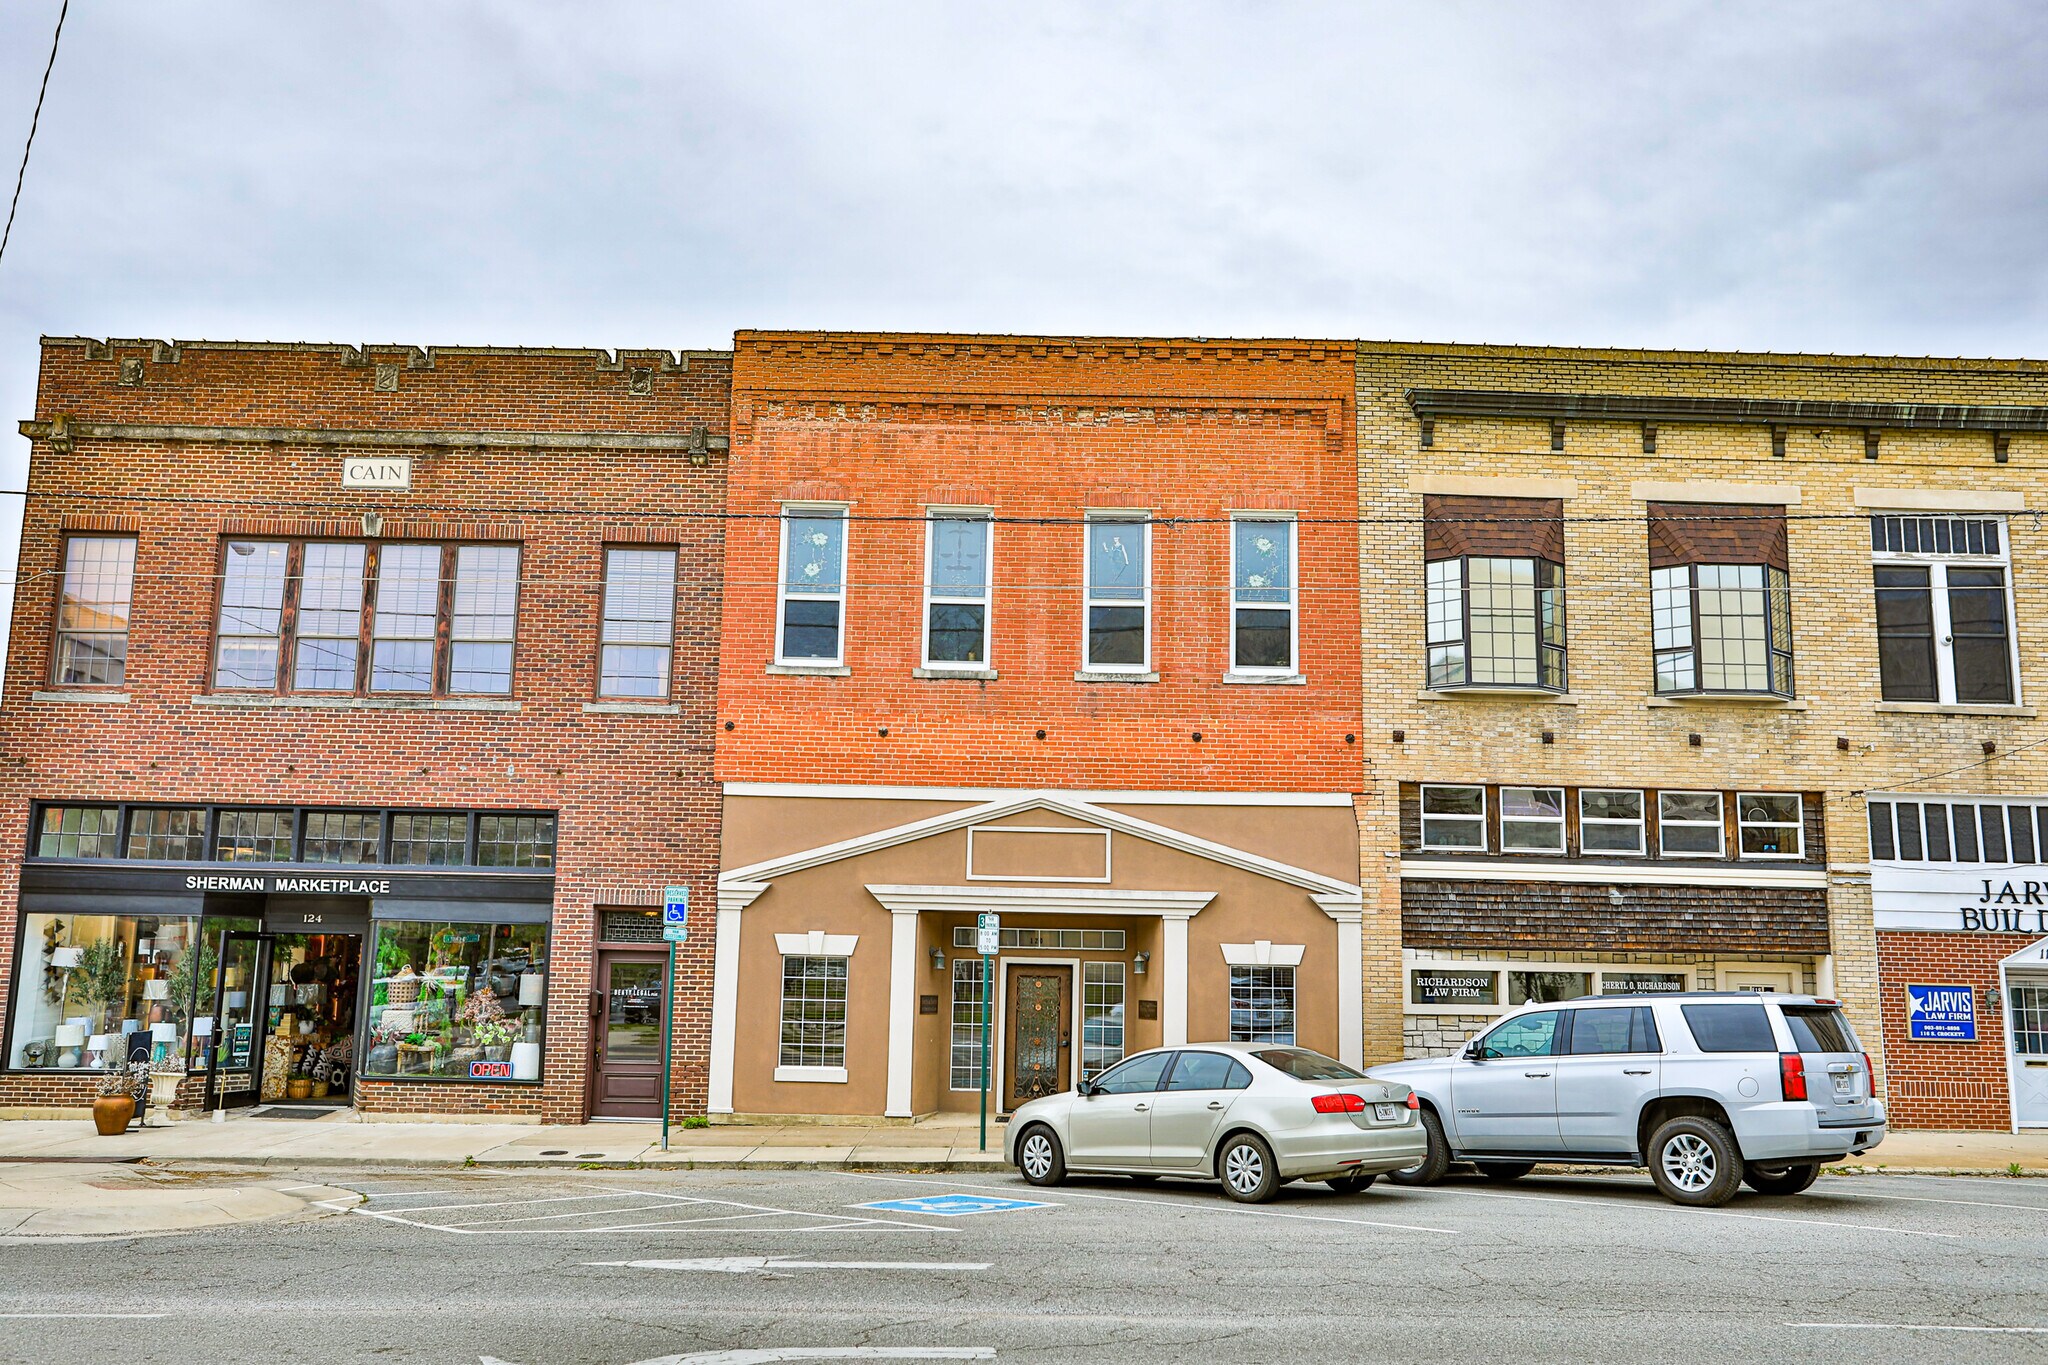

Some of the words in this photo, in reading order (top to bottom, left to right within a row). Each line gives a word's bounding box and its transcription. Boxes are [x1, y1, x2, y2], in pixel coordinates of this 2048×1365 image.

[350, 465, 402, 480] CAIN
[185, 875, 265, 891] SHERMAN
[275, 878, 390, 893] MARKETPLACE
[1980, 879, 2048, 905] JAR
[303, 914, 322, 923] 124
[980, 917, 985, 927] 3
[1416, 977, 1488, 987] RICHARDSON
[1602, 981, 1628, 990] CHERYL
[1637, 981, 1680, 990] RICHARDSON
[1425, 988, 1449, 997] LAW
[1452, 988, 1480, 997] FIRM
[1924, 991, 1971, 1012] JARVIS
[1925, 1012, 1946, 1020] LAW
[1948, 1012, 1971, 1020] FIRM
[472, 1063, 510, 1077] OPEN
